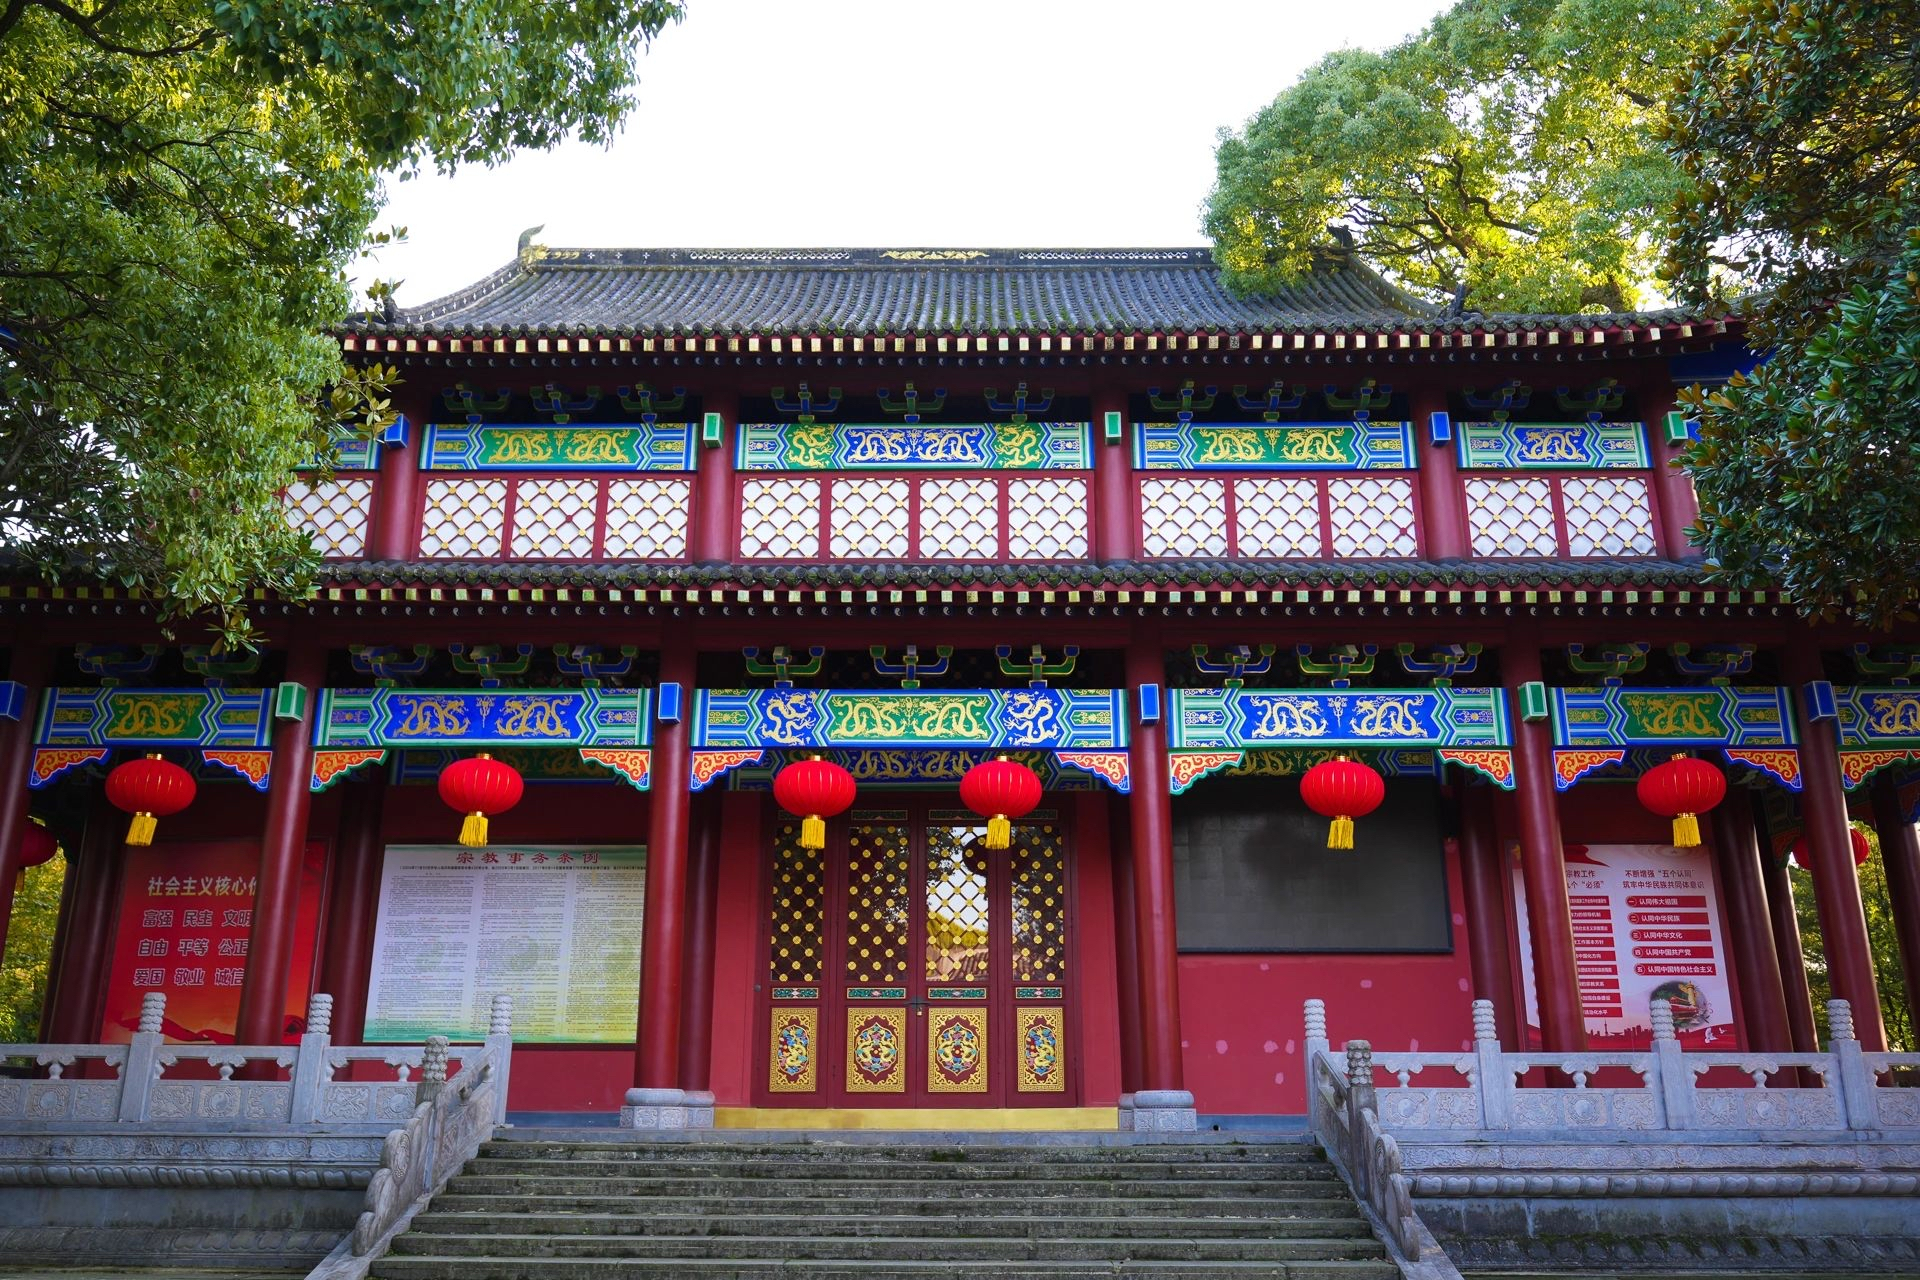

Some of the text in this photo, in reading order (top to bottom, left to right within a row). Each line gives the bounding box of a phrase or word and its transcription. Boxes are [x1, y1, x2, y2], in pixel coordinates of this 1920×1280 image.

[456, 851, 599, 865] 宗教事务条例
[143, 909, 253, 927] 富强 民主 文明
[1641, 914, 1680, 922] 认同中华民族
[1643, 931, 1683, 940] 认同中华文化
[138, 938, 249, 957] 自由 平等 公正
[1645, 947, 1691, 957] 认同中国共产党
[1648, 965, 1713, 974] 认同中国特色社会主义
[133, 968, 245, 986] 爱国 敬业 诚信
